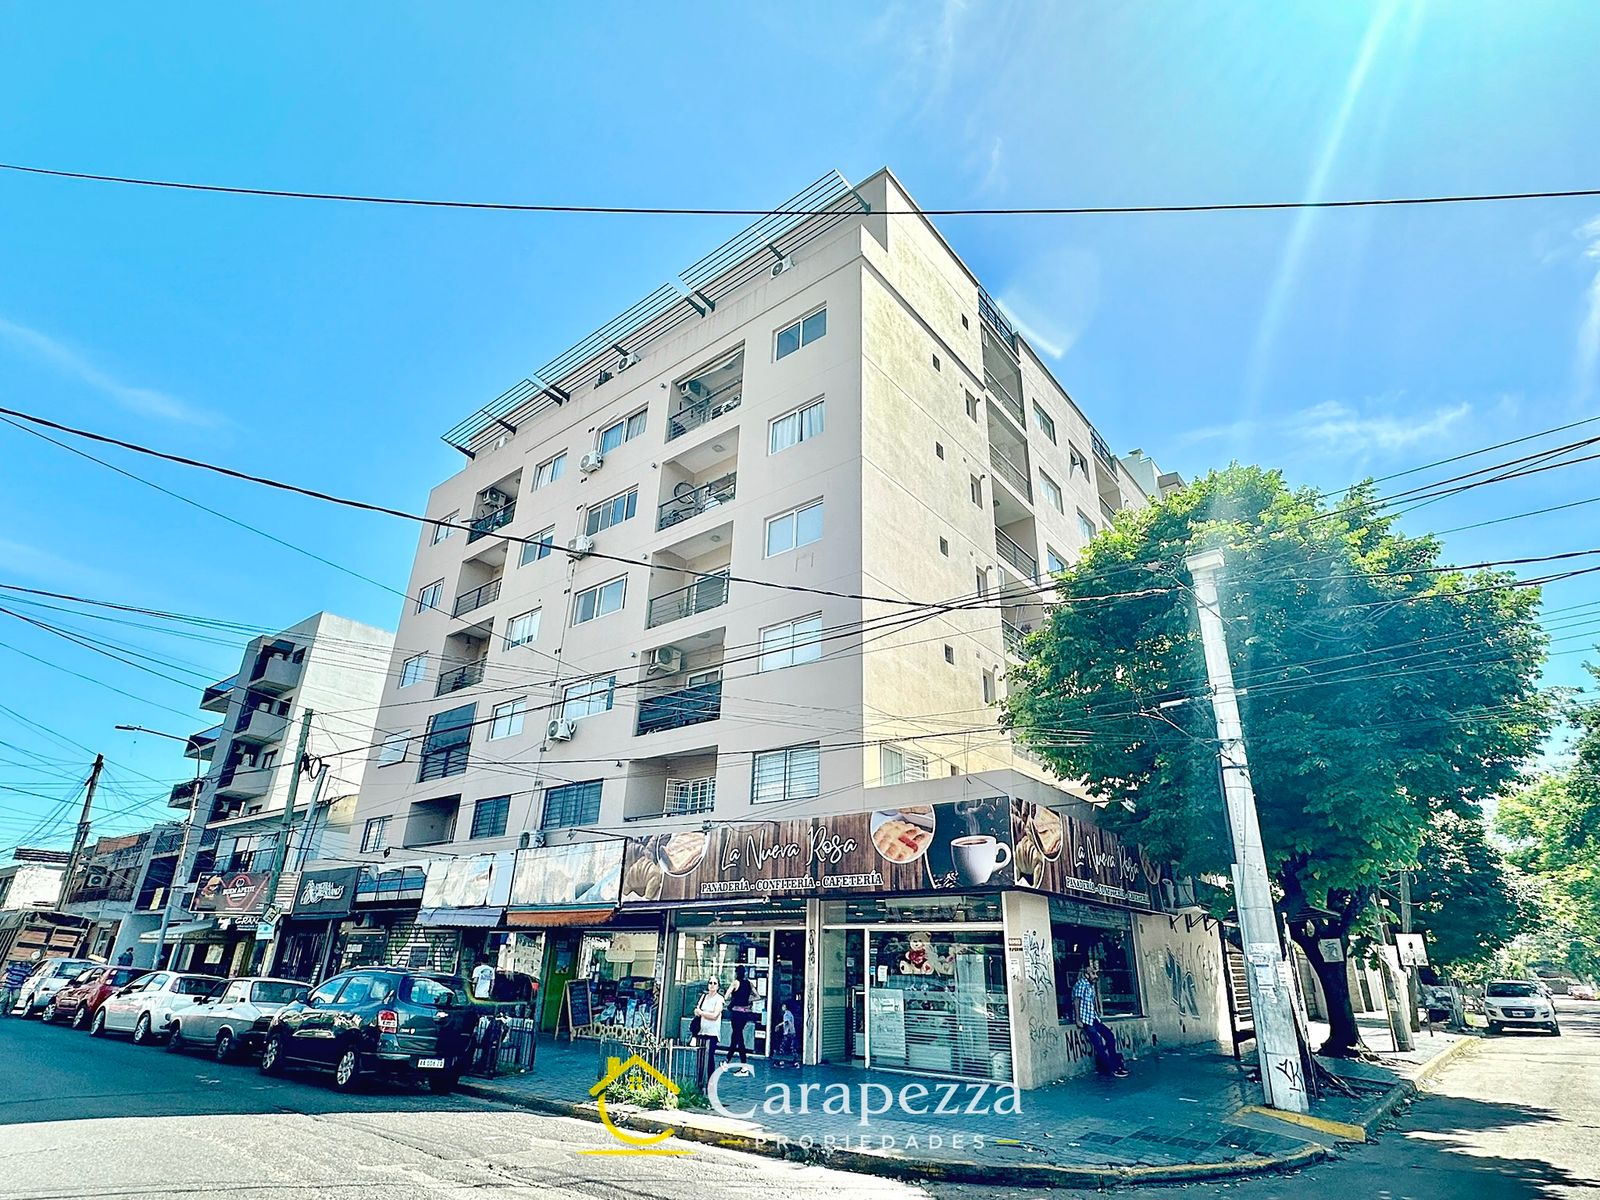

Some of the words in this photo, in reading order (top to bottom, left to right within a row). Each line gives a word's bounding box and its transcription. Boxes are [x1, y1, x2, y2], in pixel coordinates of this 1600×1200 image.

[722, 830, 741, 871] La
[746, 829, 800, 870] Nueva
[806, 825, 858, 866] Rosa
[1073, 825, 1085, 868] La
[1086, 833, 1116, 875] Nueva
[1117, 845, 1139, 882] Rosa
[701, 878, 750, 894] PANADERÍA
[756, 874, 815, 890] CONFITERÍA
[822, 870, 883, 888] CAFETERÍA
